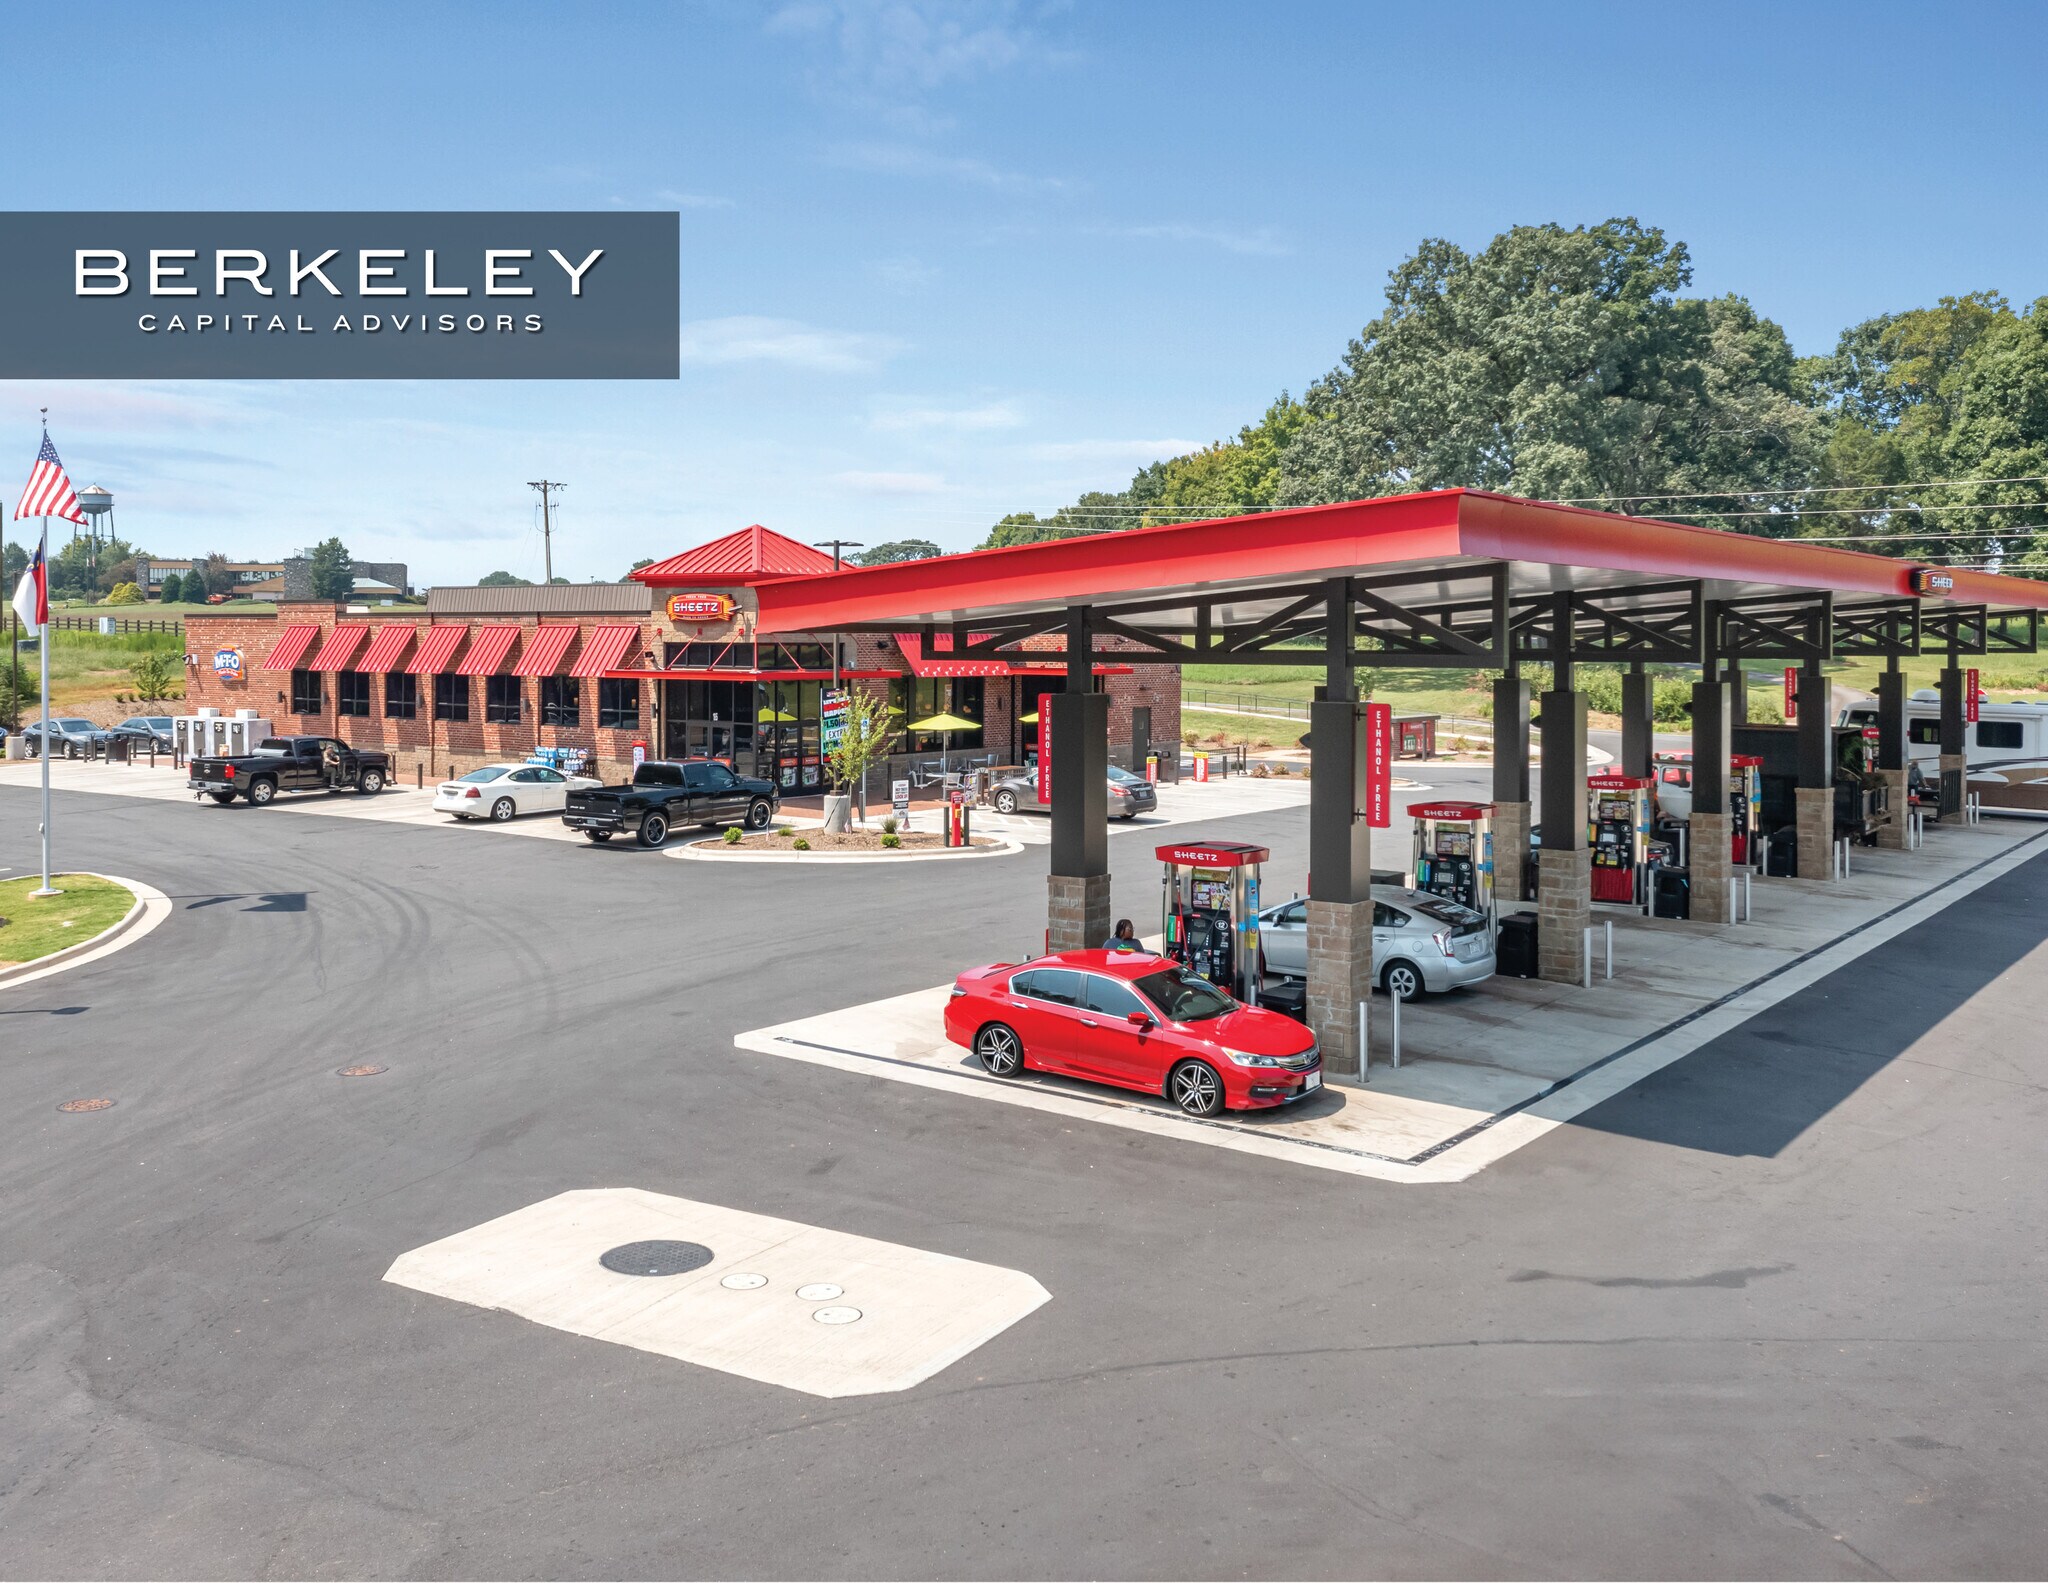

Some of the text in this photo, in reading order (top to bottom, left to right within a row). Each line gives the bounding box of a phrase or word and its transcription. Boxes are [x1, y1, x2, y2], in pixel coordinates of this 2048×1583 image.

[673, 602, 719, 612] SHEETZ
[1375, 710, 1383, 775] ETHANOL
[1423, 809, 1462, 817] SHEETZ
[1174, 850, 1218, 862] SHEETZ
